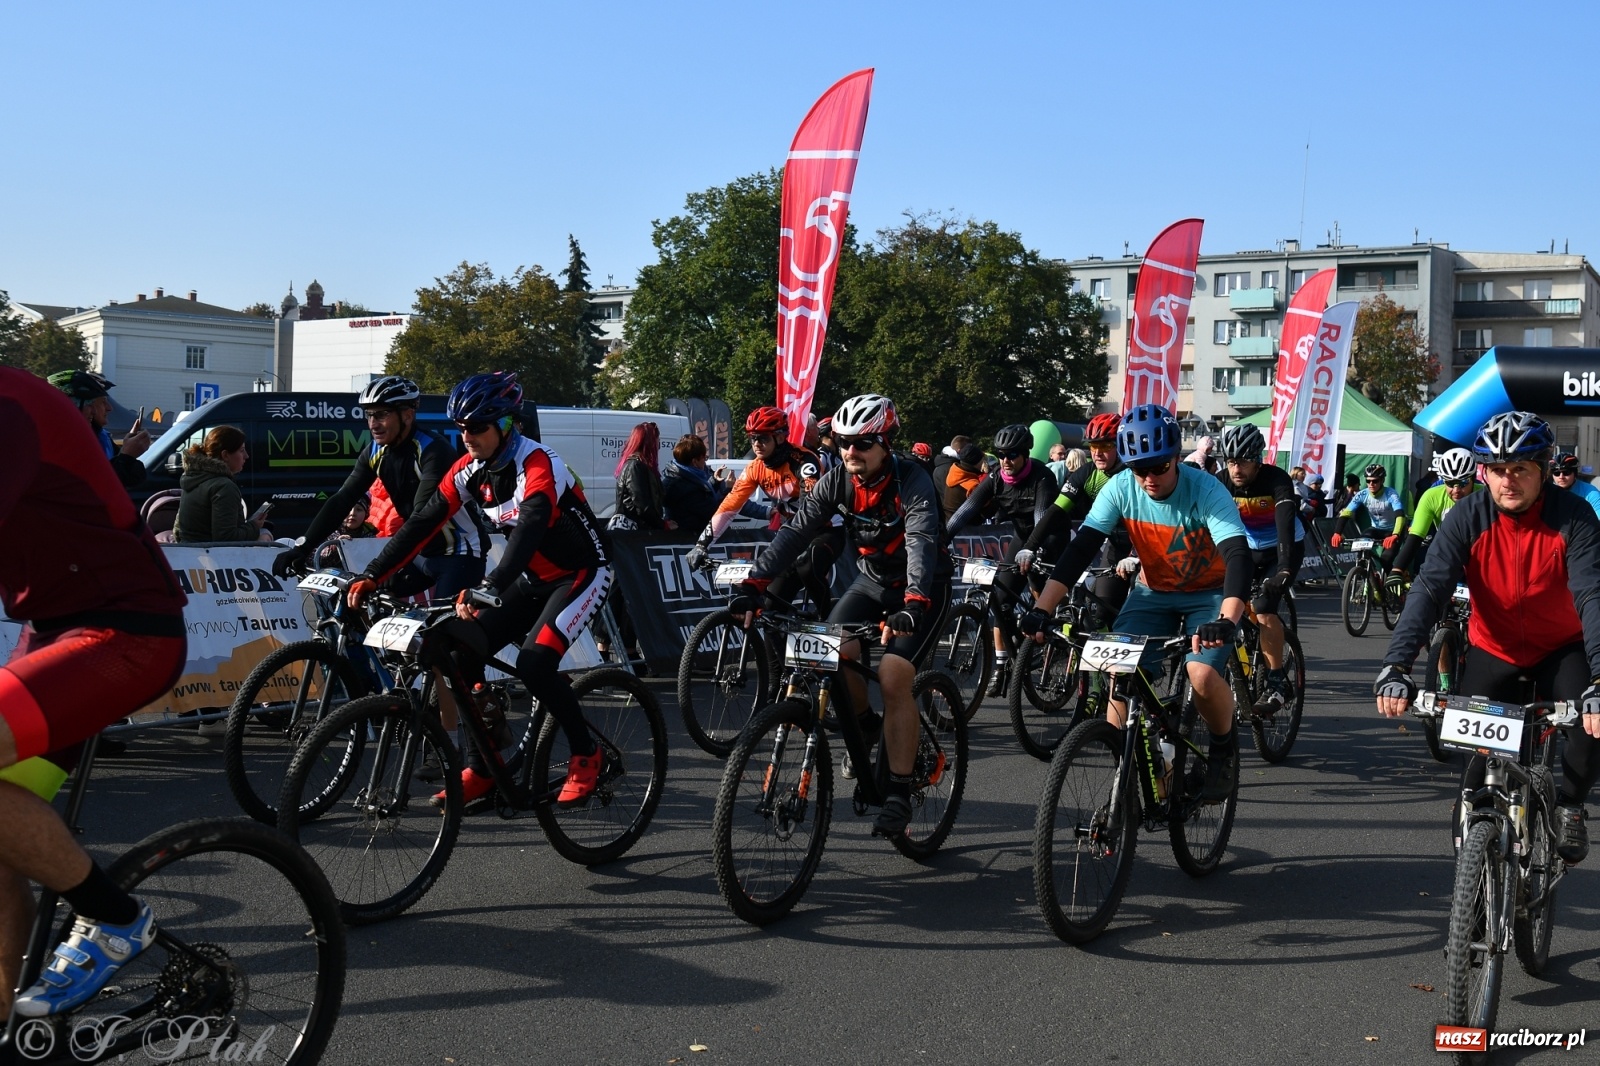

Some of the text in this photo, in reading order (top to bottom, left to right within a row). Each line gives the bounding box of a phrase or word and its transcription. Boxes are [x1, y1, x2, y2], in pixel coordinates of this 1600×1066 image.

[369, 319, 382, 327] RED
[1563, 371, 1600, 397] bik
[305, 401, 345, 419] bike
[601, 449, 622, 458] Craf
[566, 587, 598, 634] POLSKA
[377, 622, 410, 637] 1753
[795, 639, 829, 655] 1015
[1090, 646, 1130, 660] 2619
[1457, 718, 1510, 741] 3160
